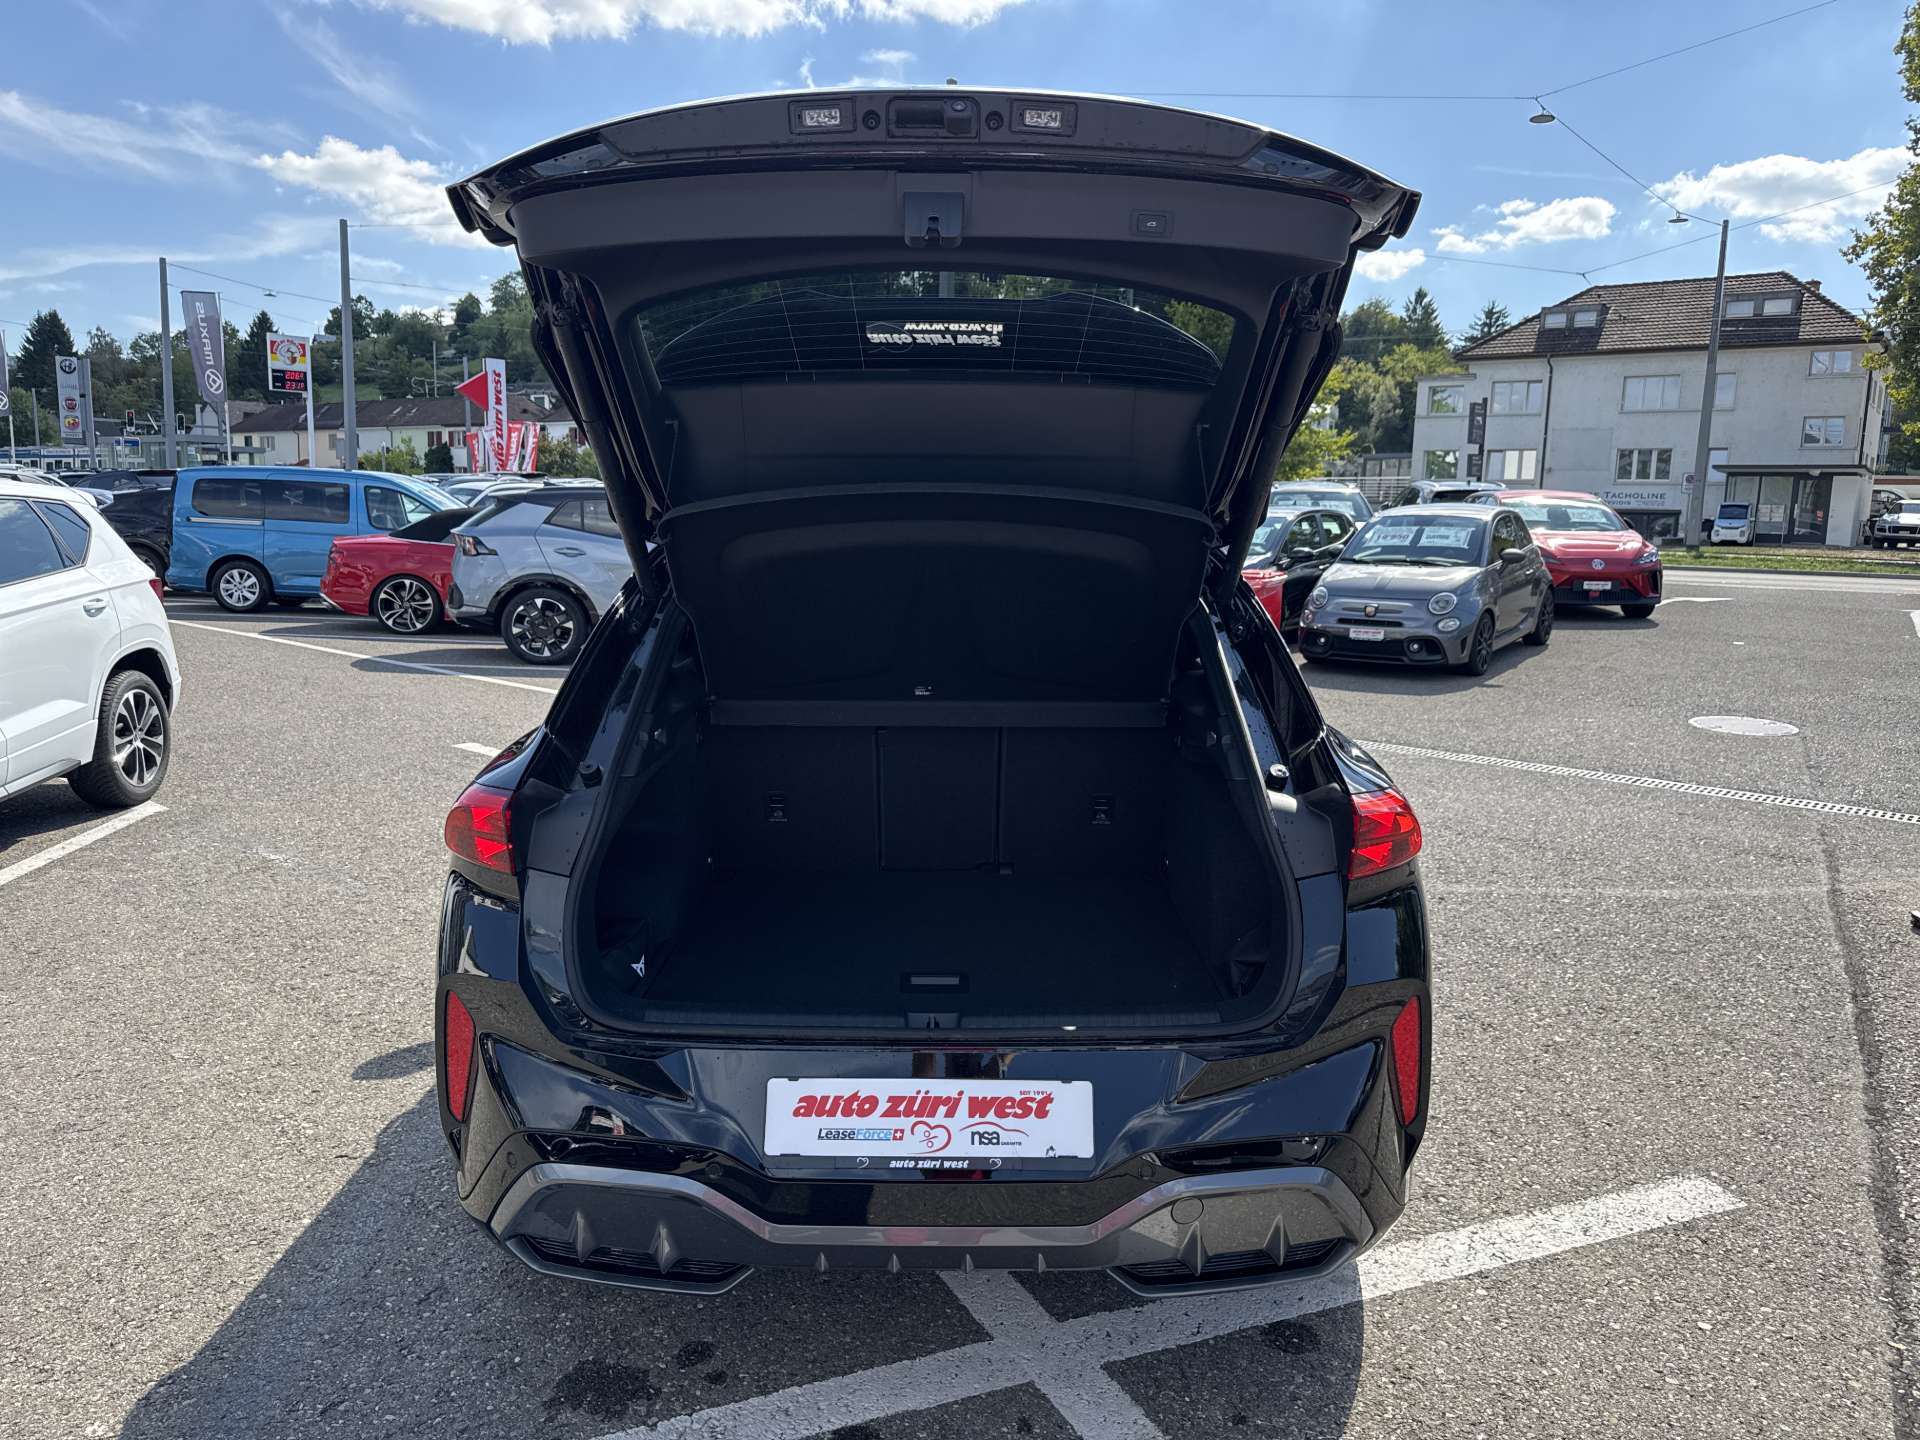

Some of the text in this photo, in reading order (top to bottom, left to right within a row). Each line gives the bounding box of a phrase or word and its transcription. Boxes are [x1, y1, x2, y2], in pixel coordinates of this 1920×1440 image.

[492, 369, 503, 406] west
[1604, 491, 1666, 500] TACHOLINE
[792, 1089, 1055, 1119] auto züri west
[817, 1127, 893, 1140] LeaseForce
[970, 1130, 1001, 1146] nsa
[889, 1159, 969, 1169] auto züri west
